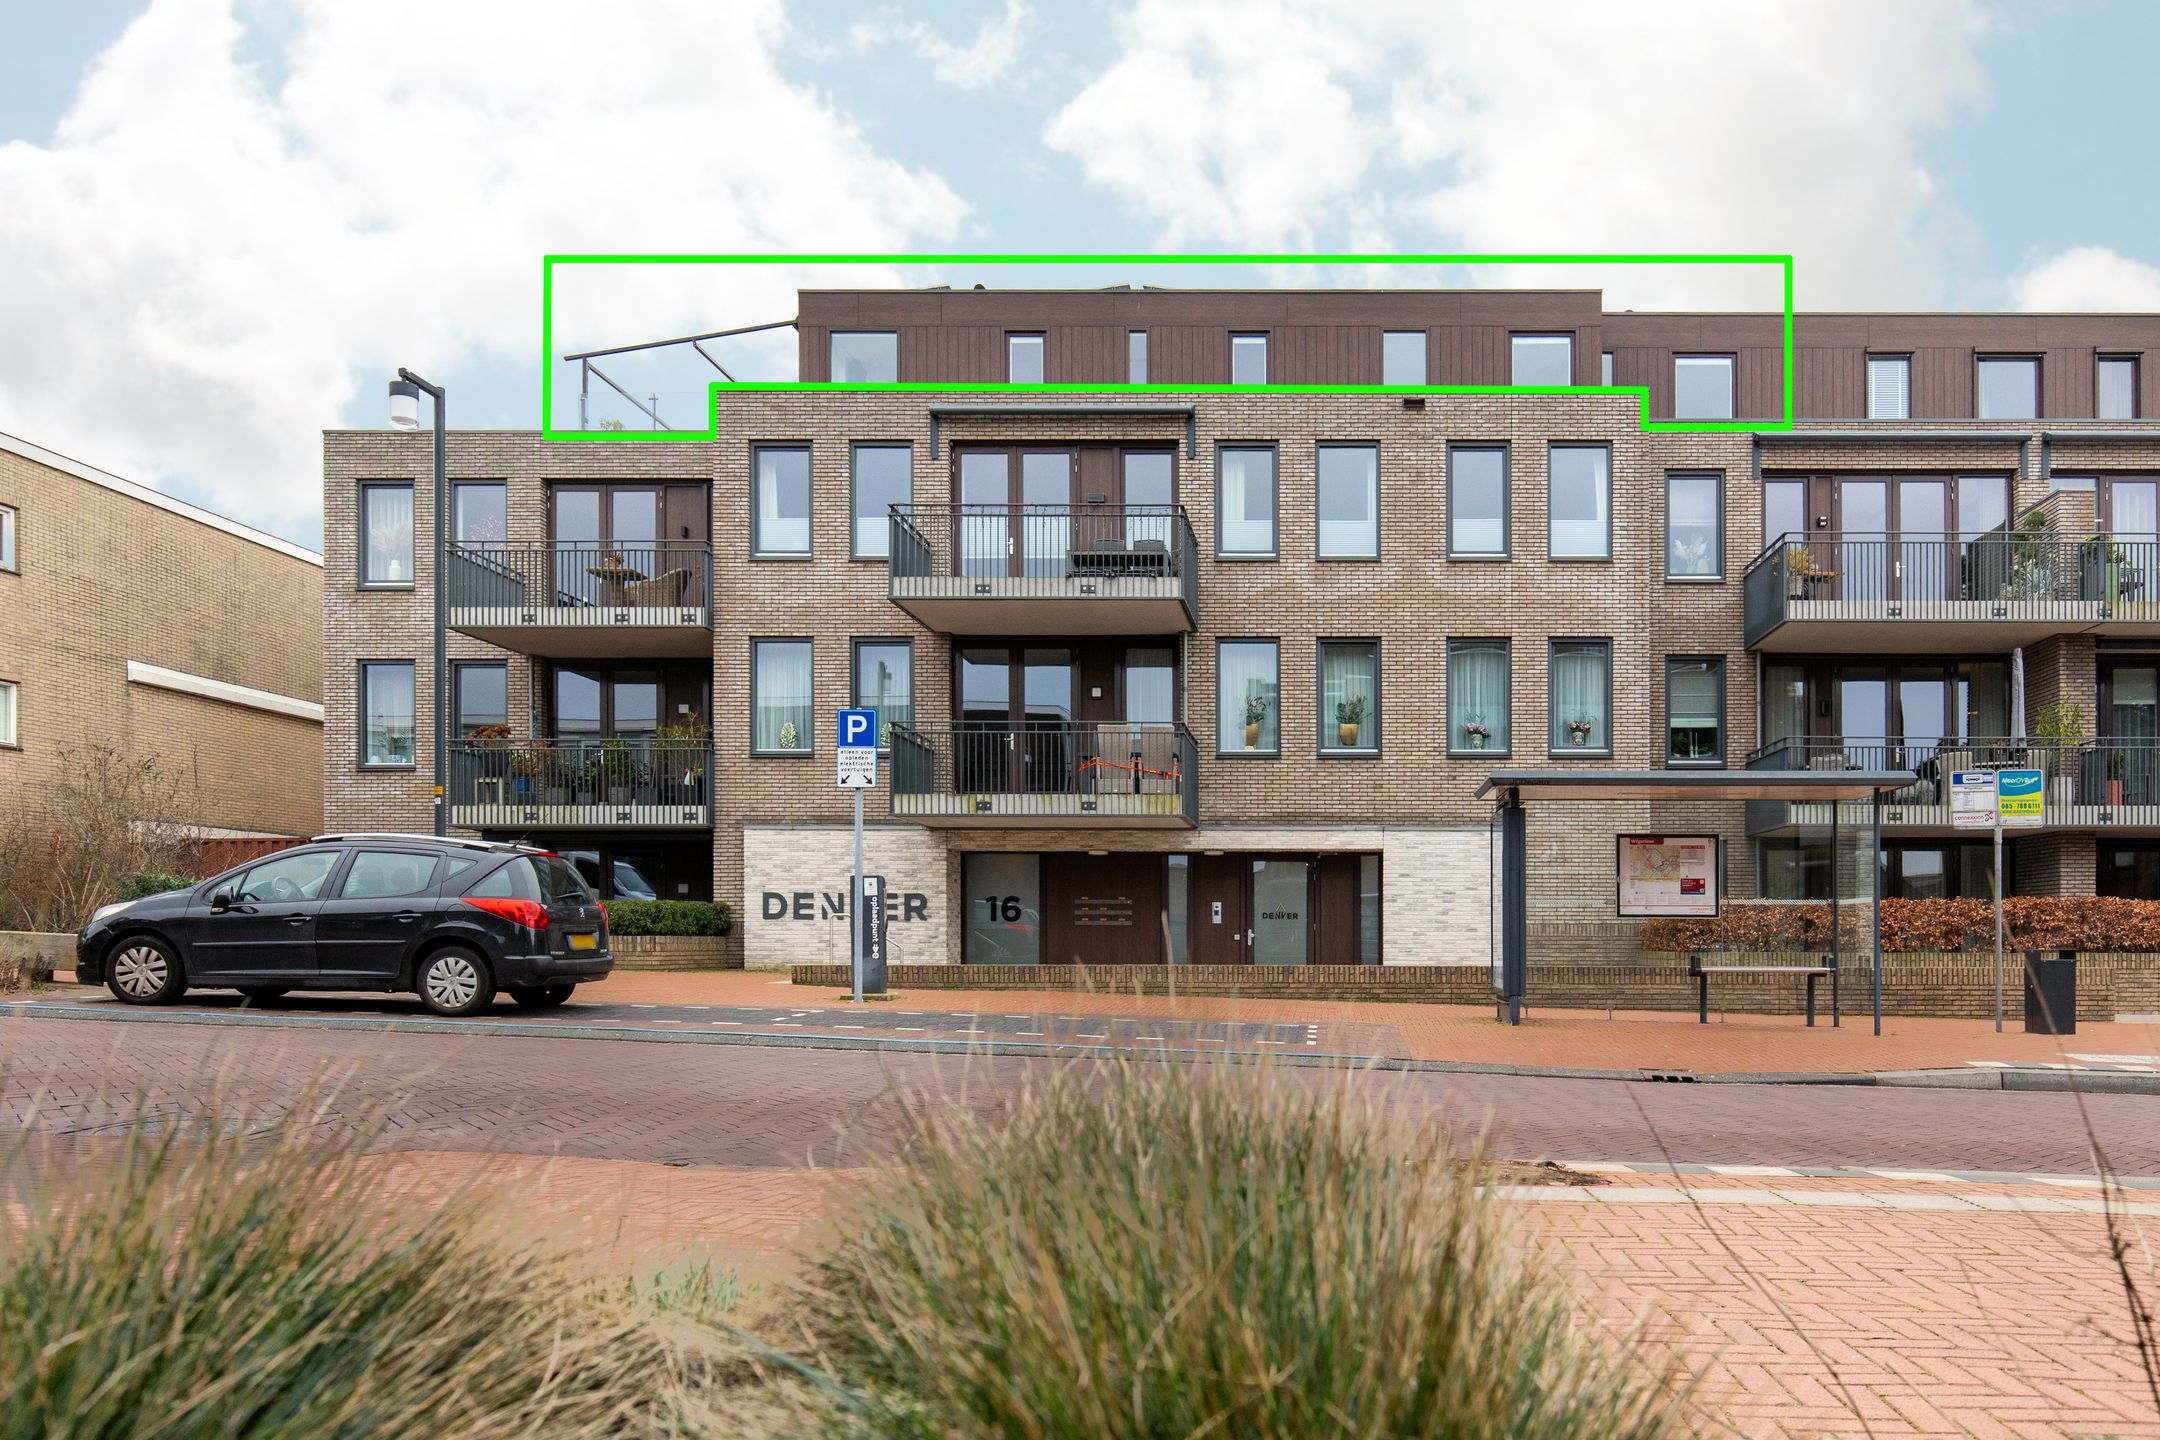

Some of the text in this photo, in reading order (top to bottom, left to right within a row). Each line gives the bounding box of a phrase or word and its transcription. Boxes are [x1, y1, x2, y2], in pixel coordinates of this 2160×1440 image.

[847, 715, 867, 743] P
[762, 892, 928, 921] DENER
[871, 896, 880, 942] oplaadpunt
[985, 896, 1022, 922] 16
[1262, 911, 1299, 920] DENVER
